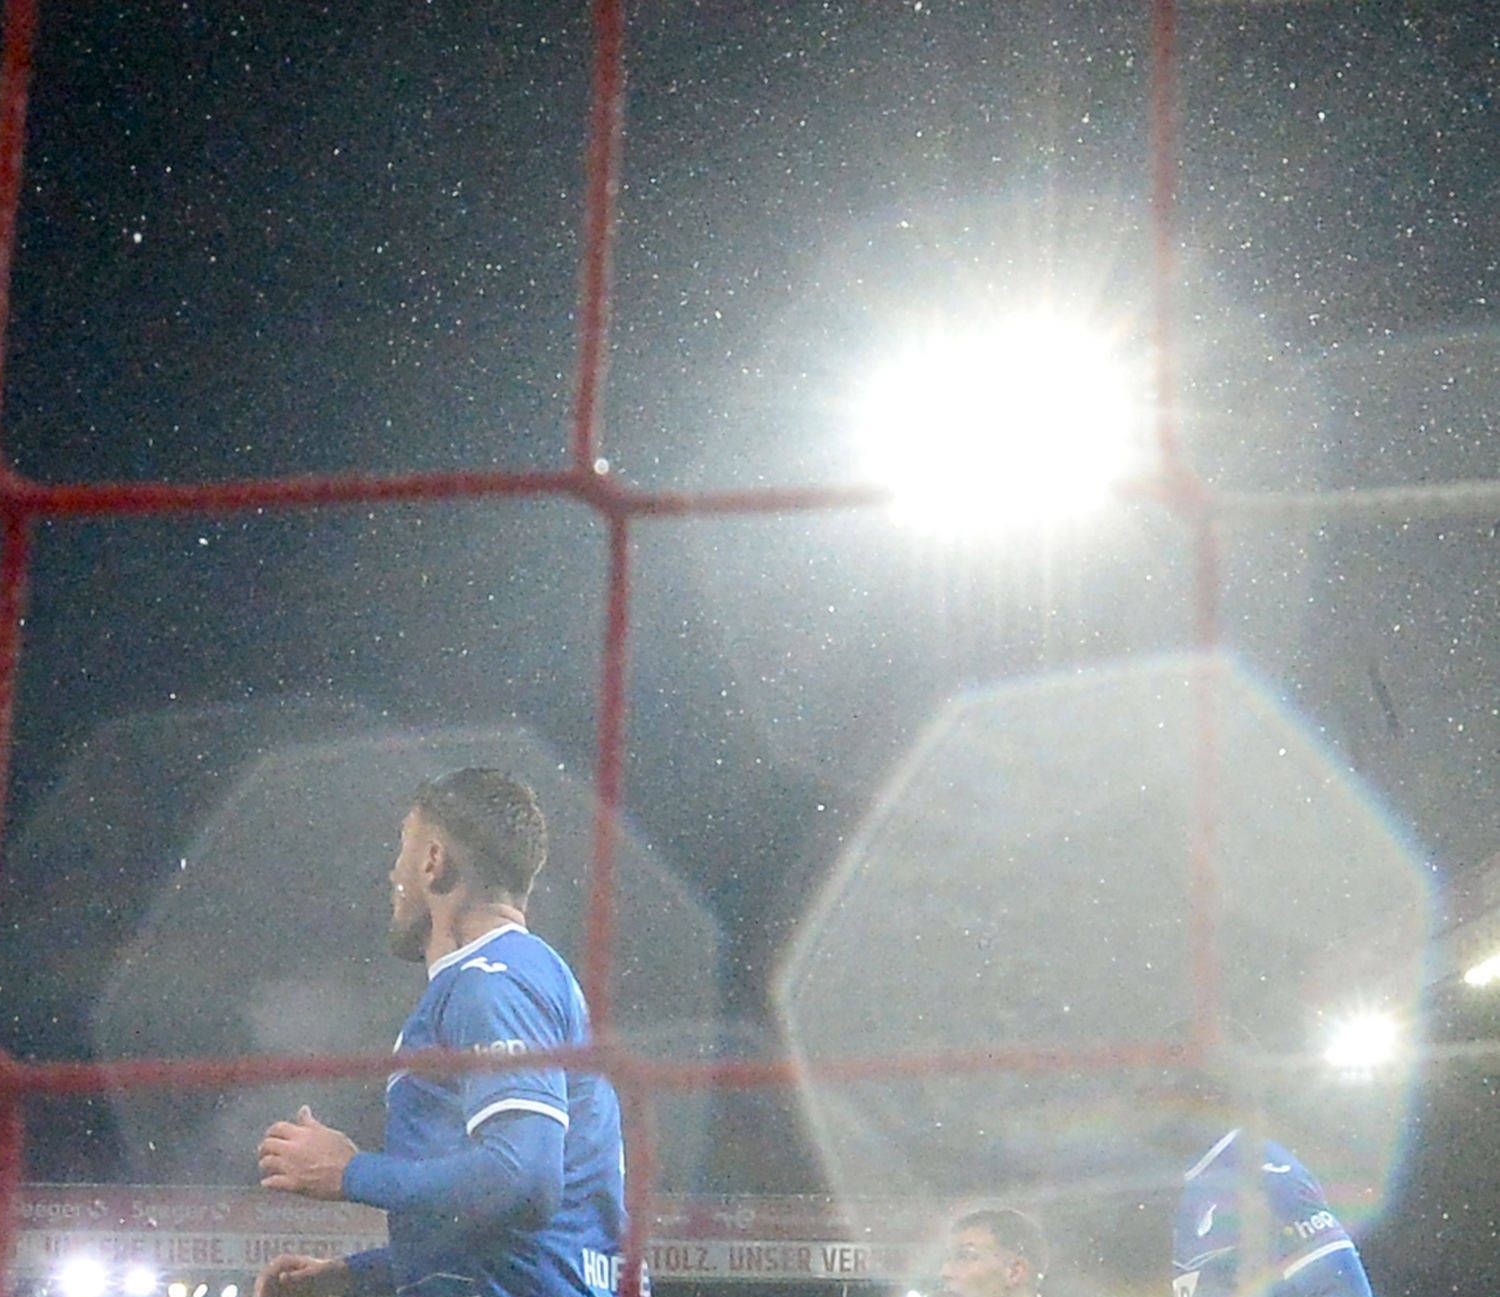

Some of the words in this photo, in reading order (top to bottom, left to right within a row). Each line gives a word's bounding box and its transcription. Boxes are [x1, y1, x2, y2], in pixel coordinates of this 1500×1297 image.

[1296, 1210, 1333, 1238] hep
[653, 1246, 717, 1272] TOLZ.
[729, 1246, 811, 1273] UNSER
